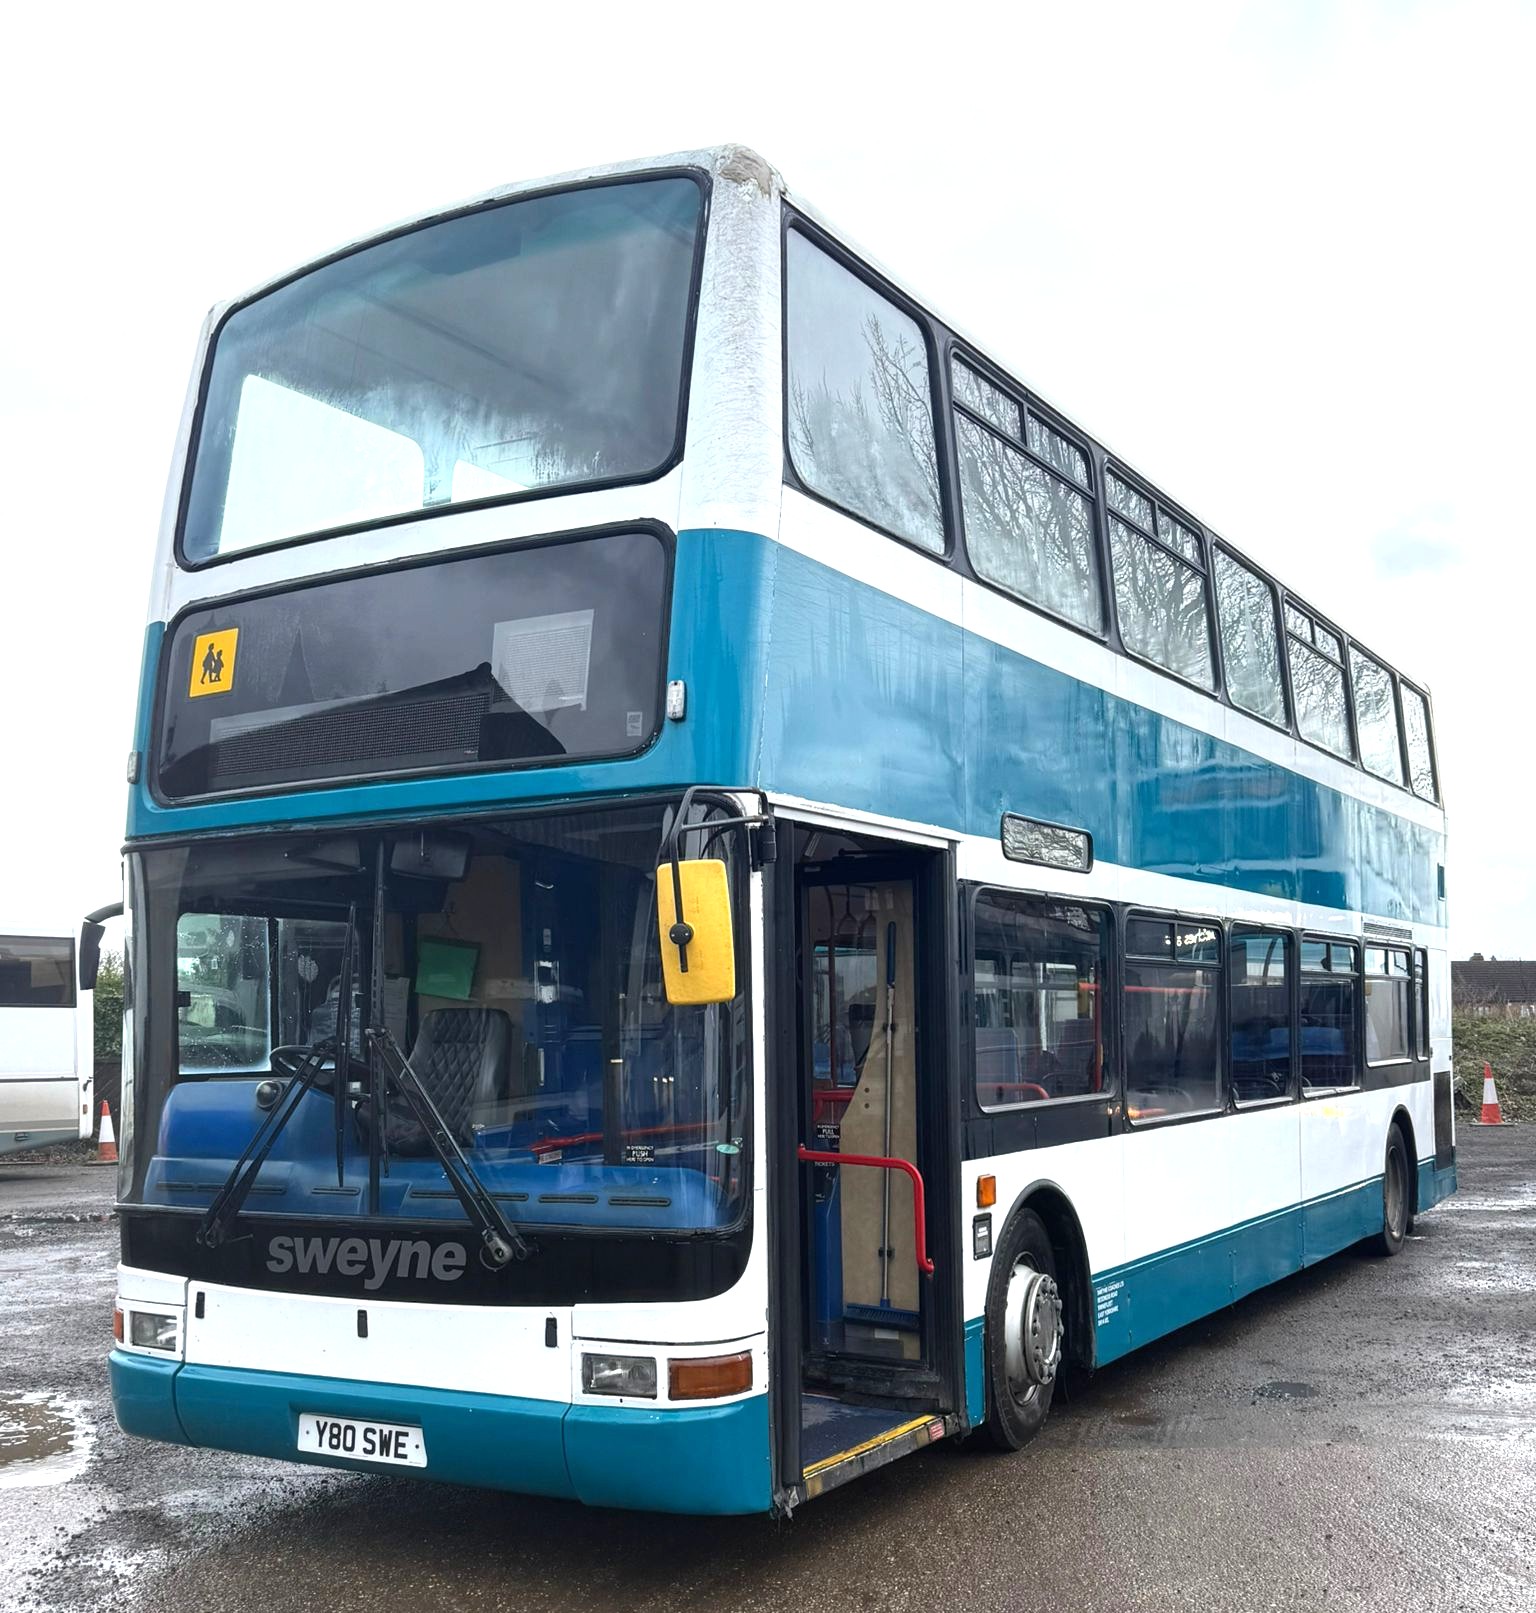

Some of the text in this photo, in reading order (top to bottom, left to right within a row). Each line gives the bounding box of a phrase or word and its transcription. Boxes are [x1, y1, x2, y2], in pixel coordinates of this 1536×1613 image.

[266, 1235, 467, 1290] sweyne
[315, 1420, 409, 1459] Y80 SWE
